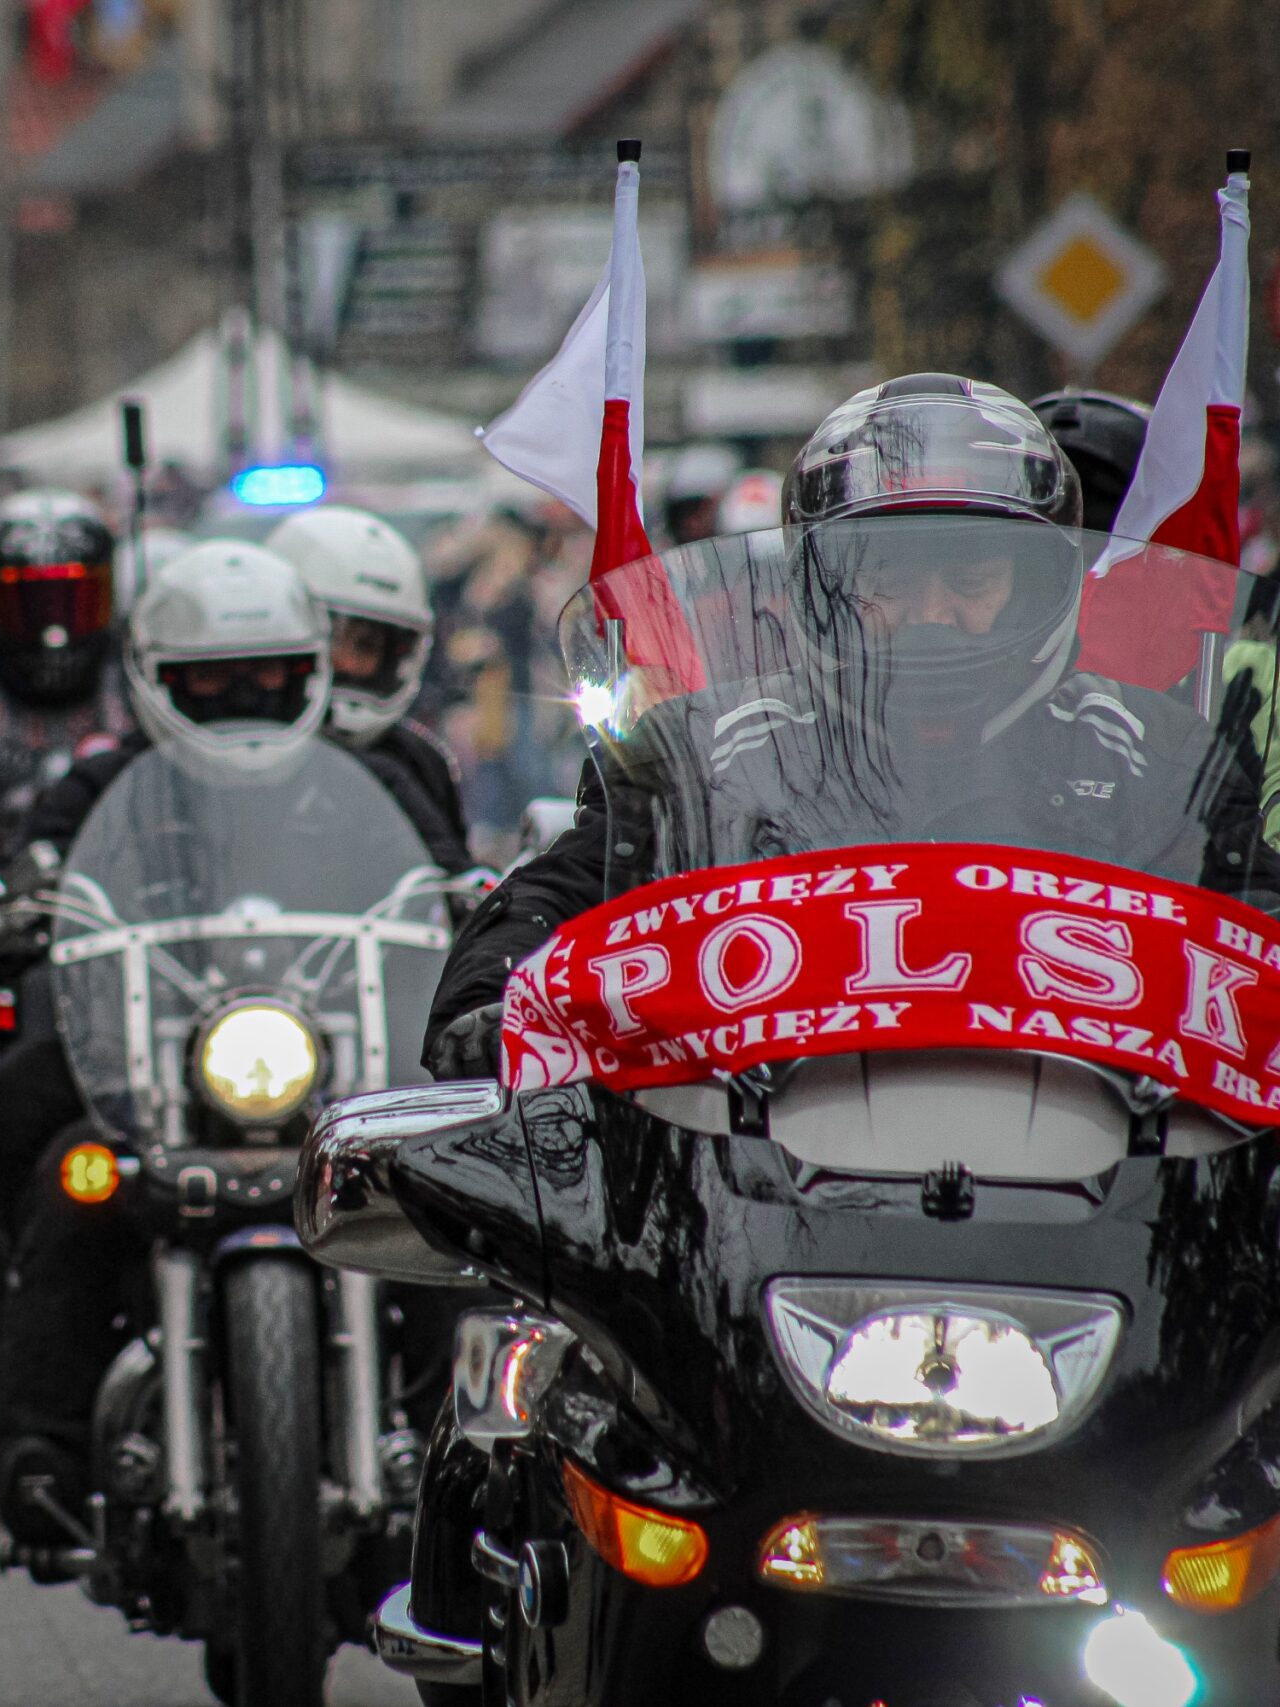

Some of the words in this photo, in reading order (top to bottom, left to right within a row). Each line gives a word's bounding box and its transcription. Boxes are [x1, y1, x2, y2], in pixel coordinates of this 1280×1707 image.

[605, 863, 909, 945] ZWYCIĘŻY
[955, 864, 1188, 926] ORZEŁ
[587, 898, 1280, 1077] POLSK
[642, 1000, 912, 1067] ZWYCIĘŻY
[968, 1003, 1190, 1078] NASZA
